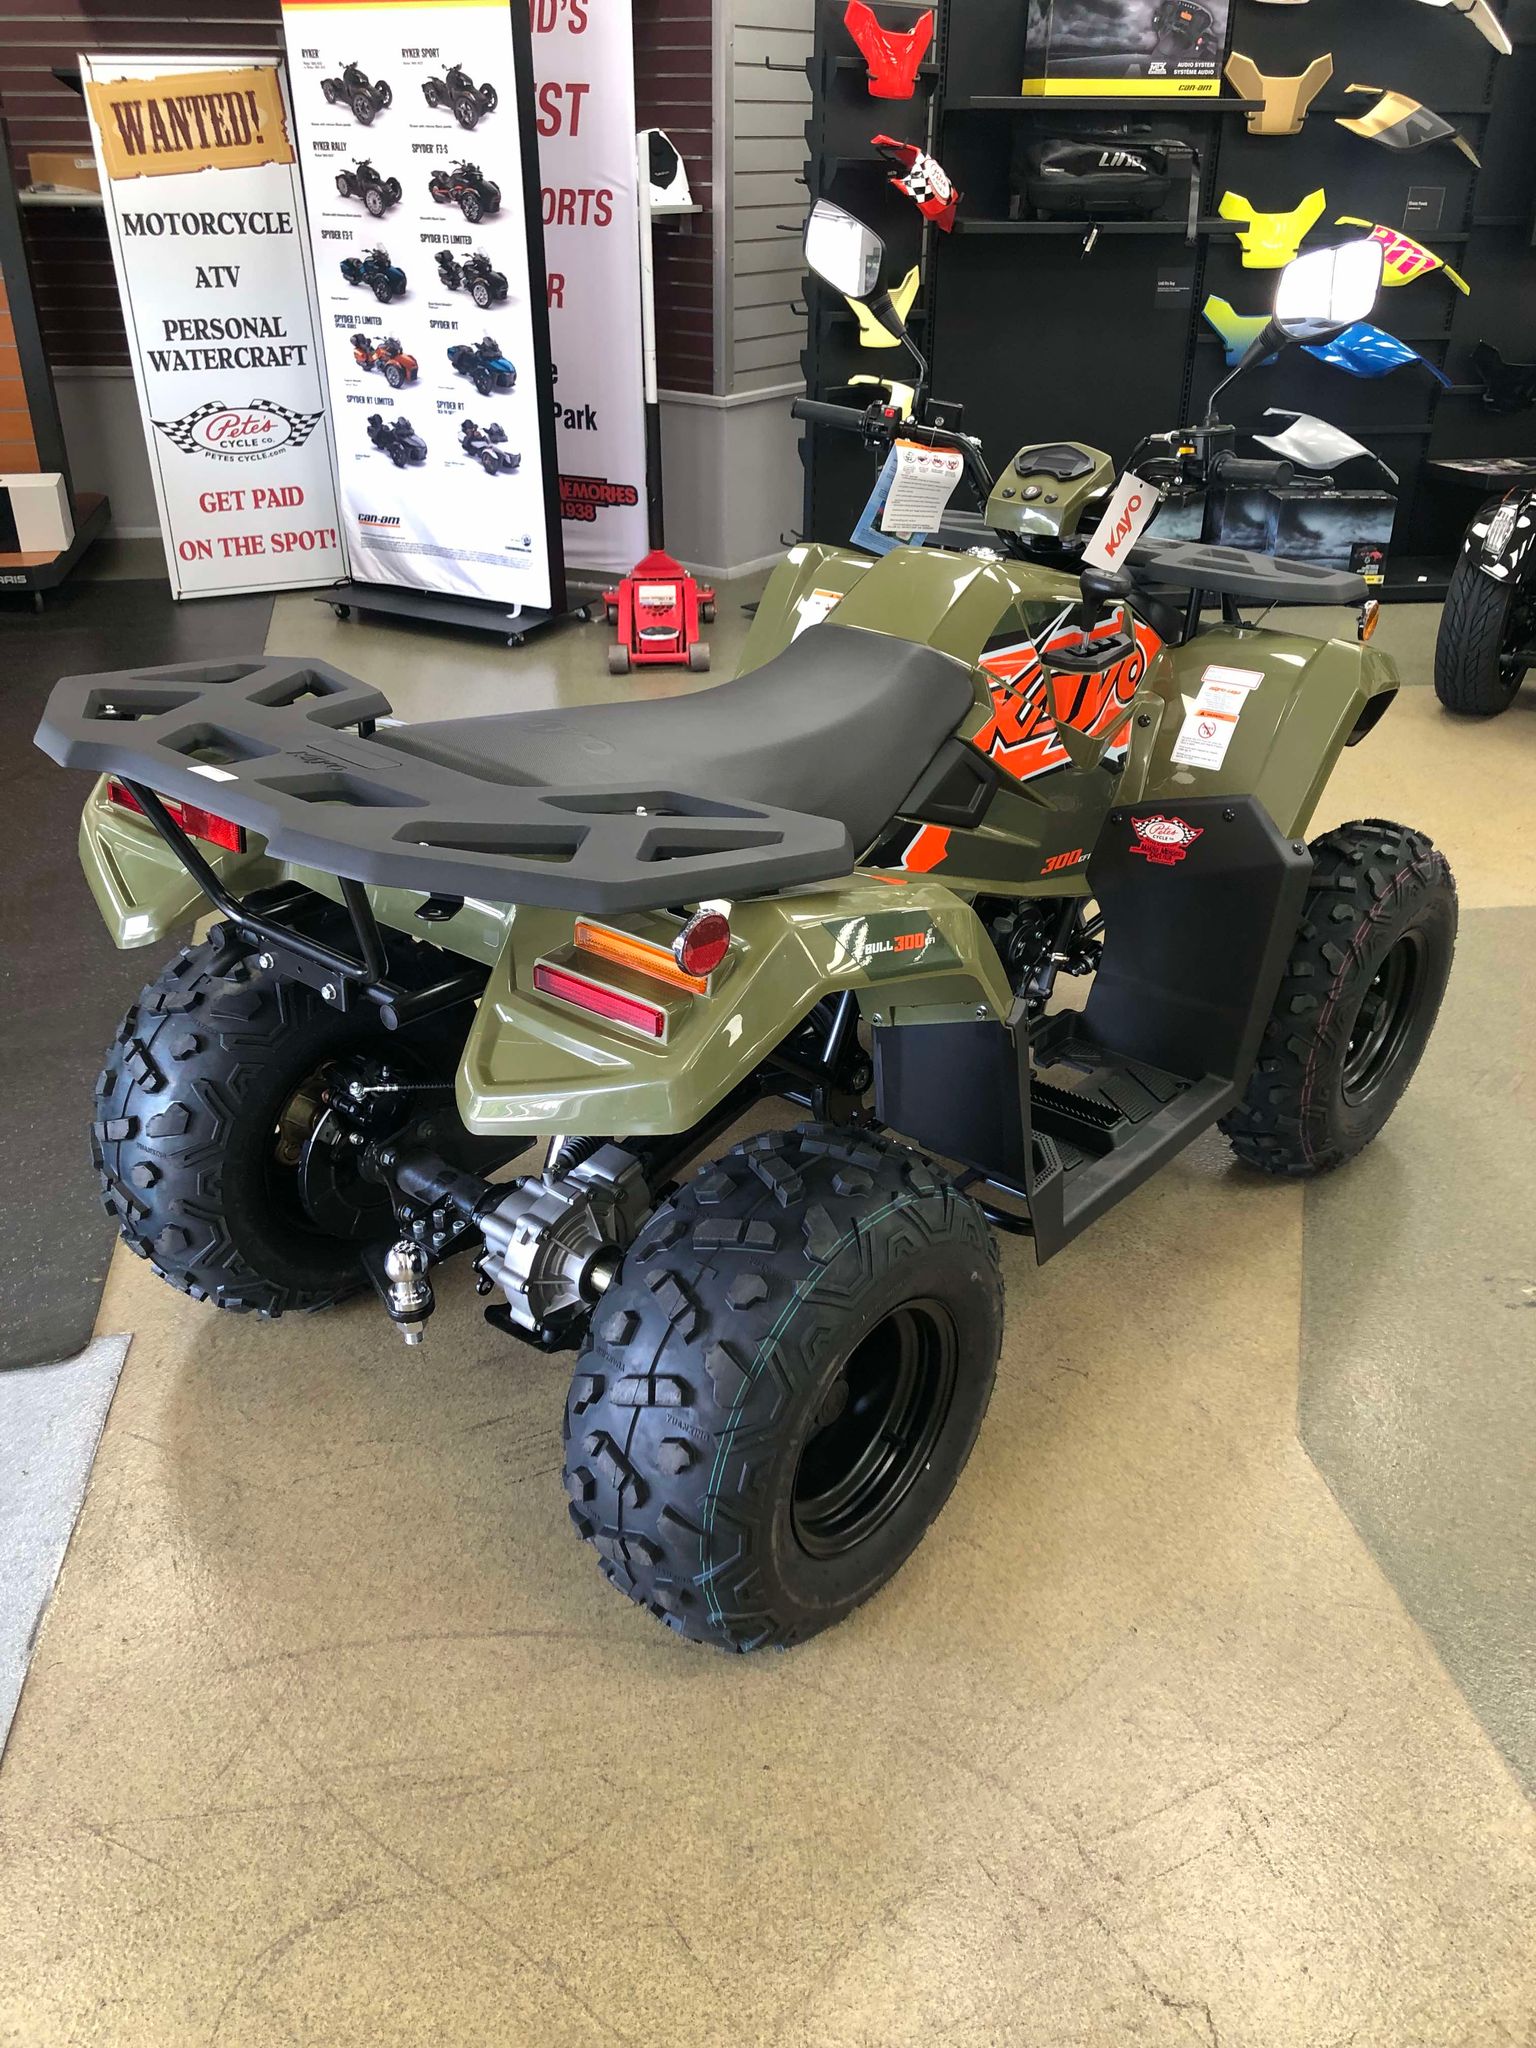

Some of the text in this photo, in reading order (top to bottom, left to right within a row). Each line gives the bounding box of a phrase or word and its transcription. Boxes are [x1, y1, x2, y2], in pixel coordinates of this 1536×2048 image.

[401, 48, 440, 59] RYKER SPORT
[534, 82, 590, 137] ST
[110, 90, 264, 156] WANTED!
[312, 141, 347, 151] RYKER RALLY
[411, 143, 434, 154] SPYDER
[121, 212, 293, 236] MOTORCYCLE
[321, 229, 341, 240] SPYDER
[419, 233, 472, 245] SPYDER F3 LIMITED
[195, 266, 240, 288] ATV
[334, 314, 353, 324] SPYDER
[362, 315, 382, 326] LIMITED
[429, 319, 450, 329] SPYDER
[162, 316, 287, 341] PERSONAL
[147, 345, 307, 372] WATERCRAFT
[346, 395, 366, 404] SPYDER
[374, 396, 394, 406] LIMITED
[436, 400, 456, 410] SPYDER
[205, 413, 278, 441] Pete's
[220, 438, 258, 449] CYCLE
[205, 451, 235, 462] PETES
[199, 486, 304, 513] GET PAID
[357, 512, 400, 525] can-am
[179, 539, 213, 561] ON
[217, 535, 266, 558] THE
[270, 528, 337, 553] SPOT!
[864, 940, 893, 955] BULL
